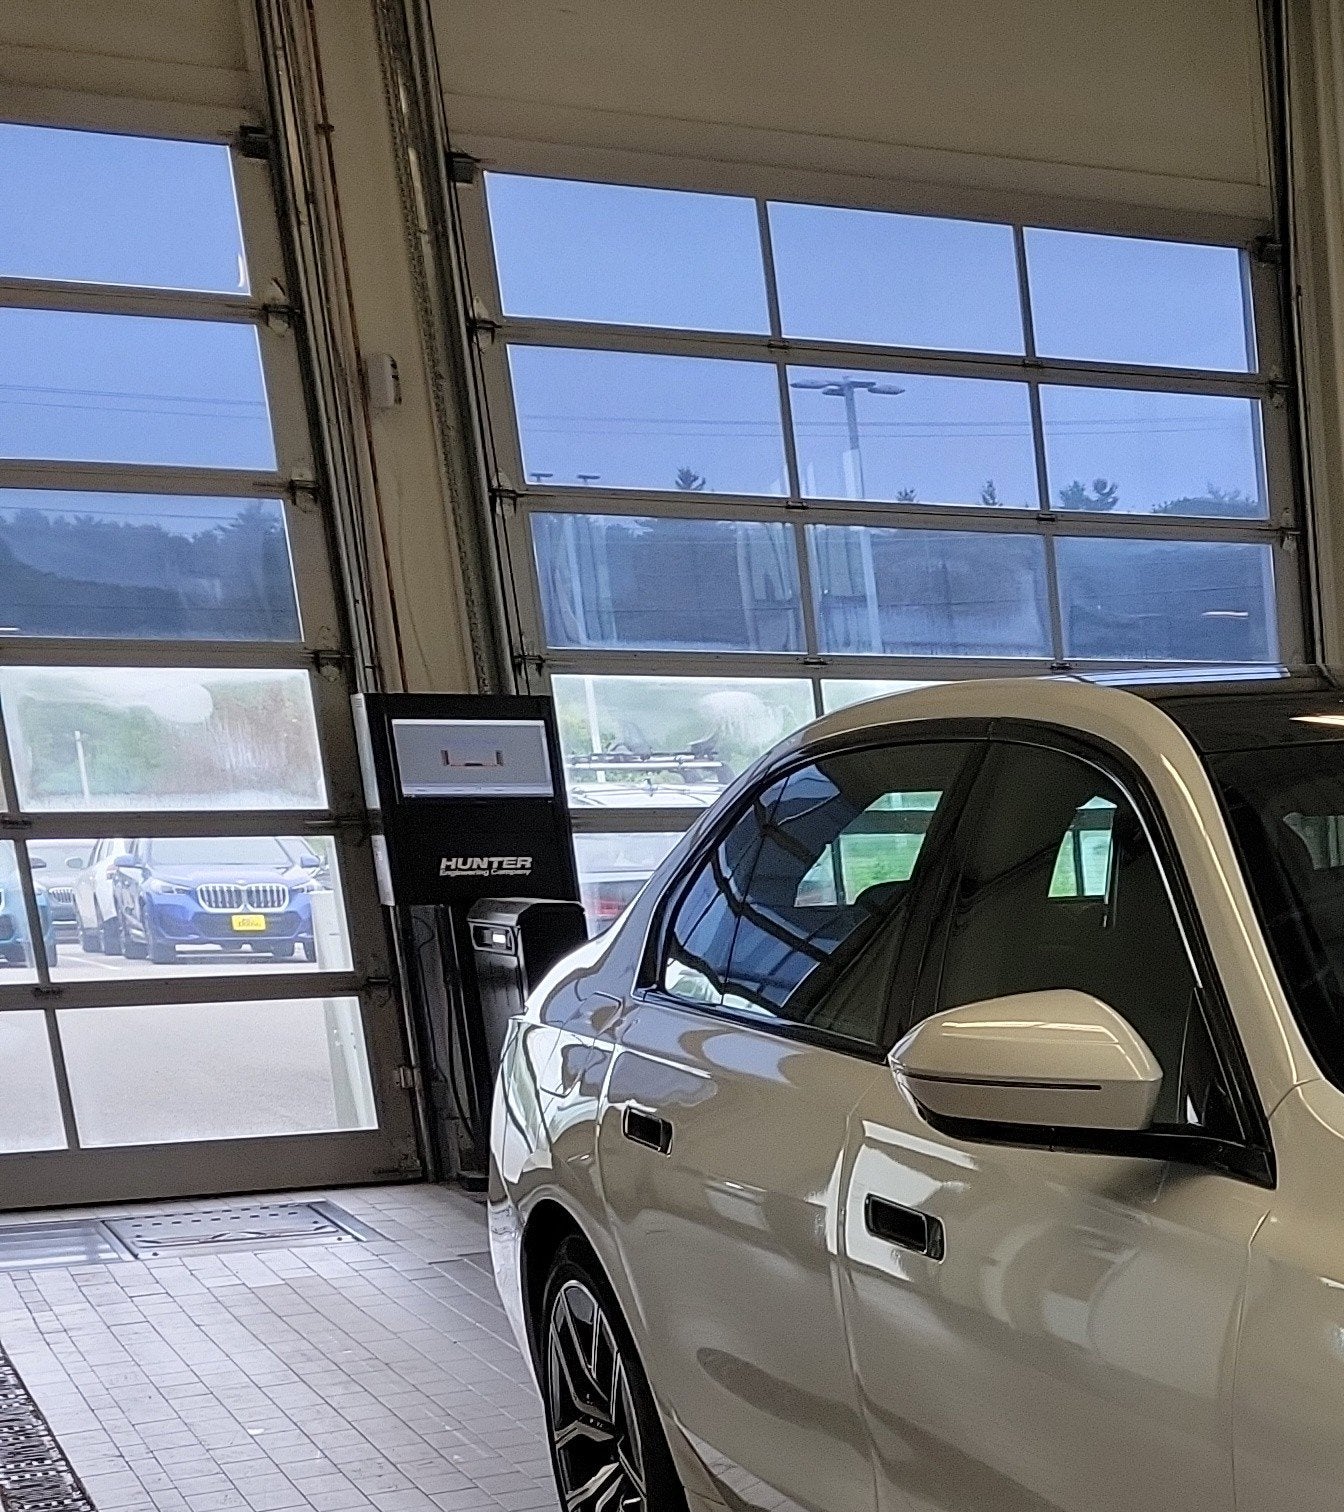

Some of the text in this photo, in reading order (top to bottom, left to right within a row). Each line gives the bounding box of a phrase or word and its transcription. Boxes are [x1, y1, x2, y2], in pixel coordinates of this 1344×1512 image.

[440, 856, 532, 869] HUNTER
[440, 868, 532, 877] Engineering Company
